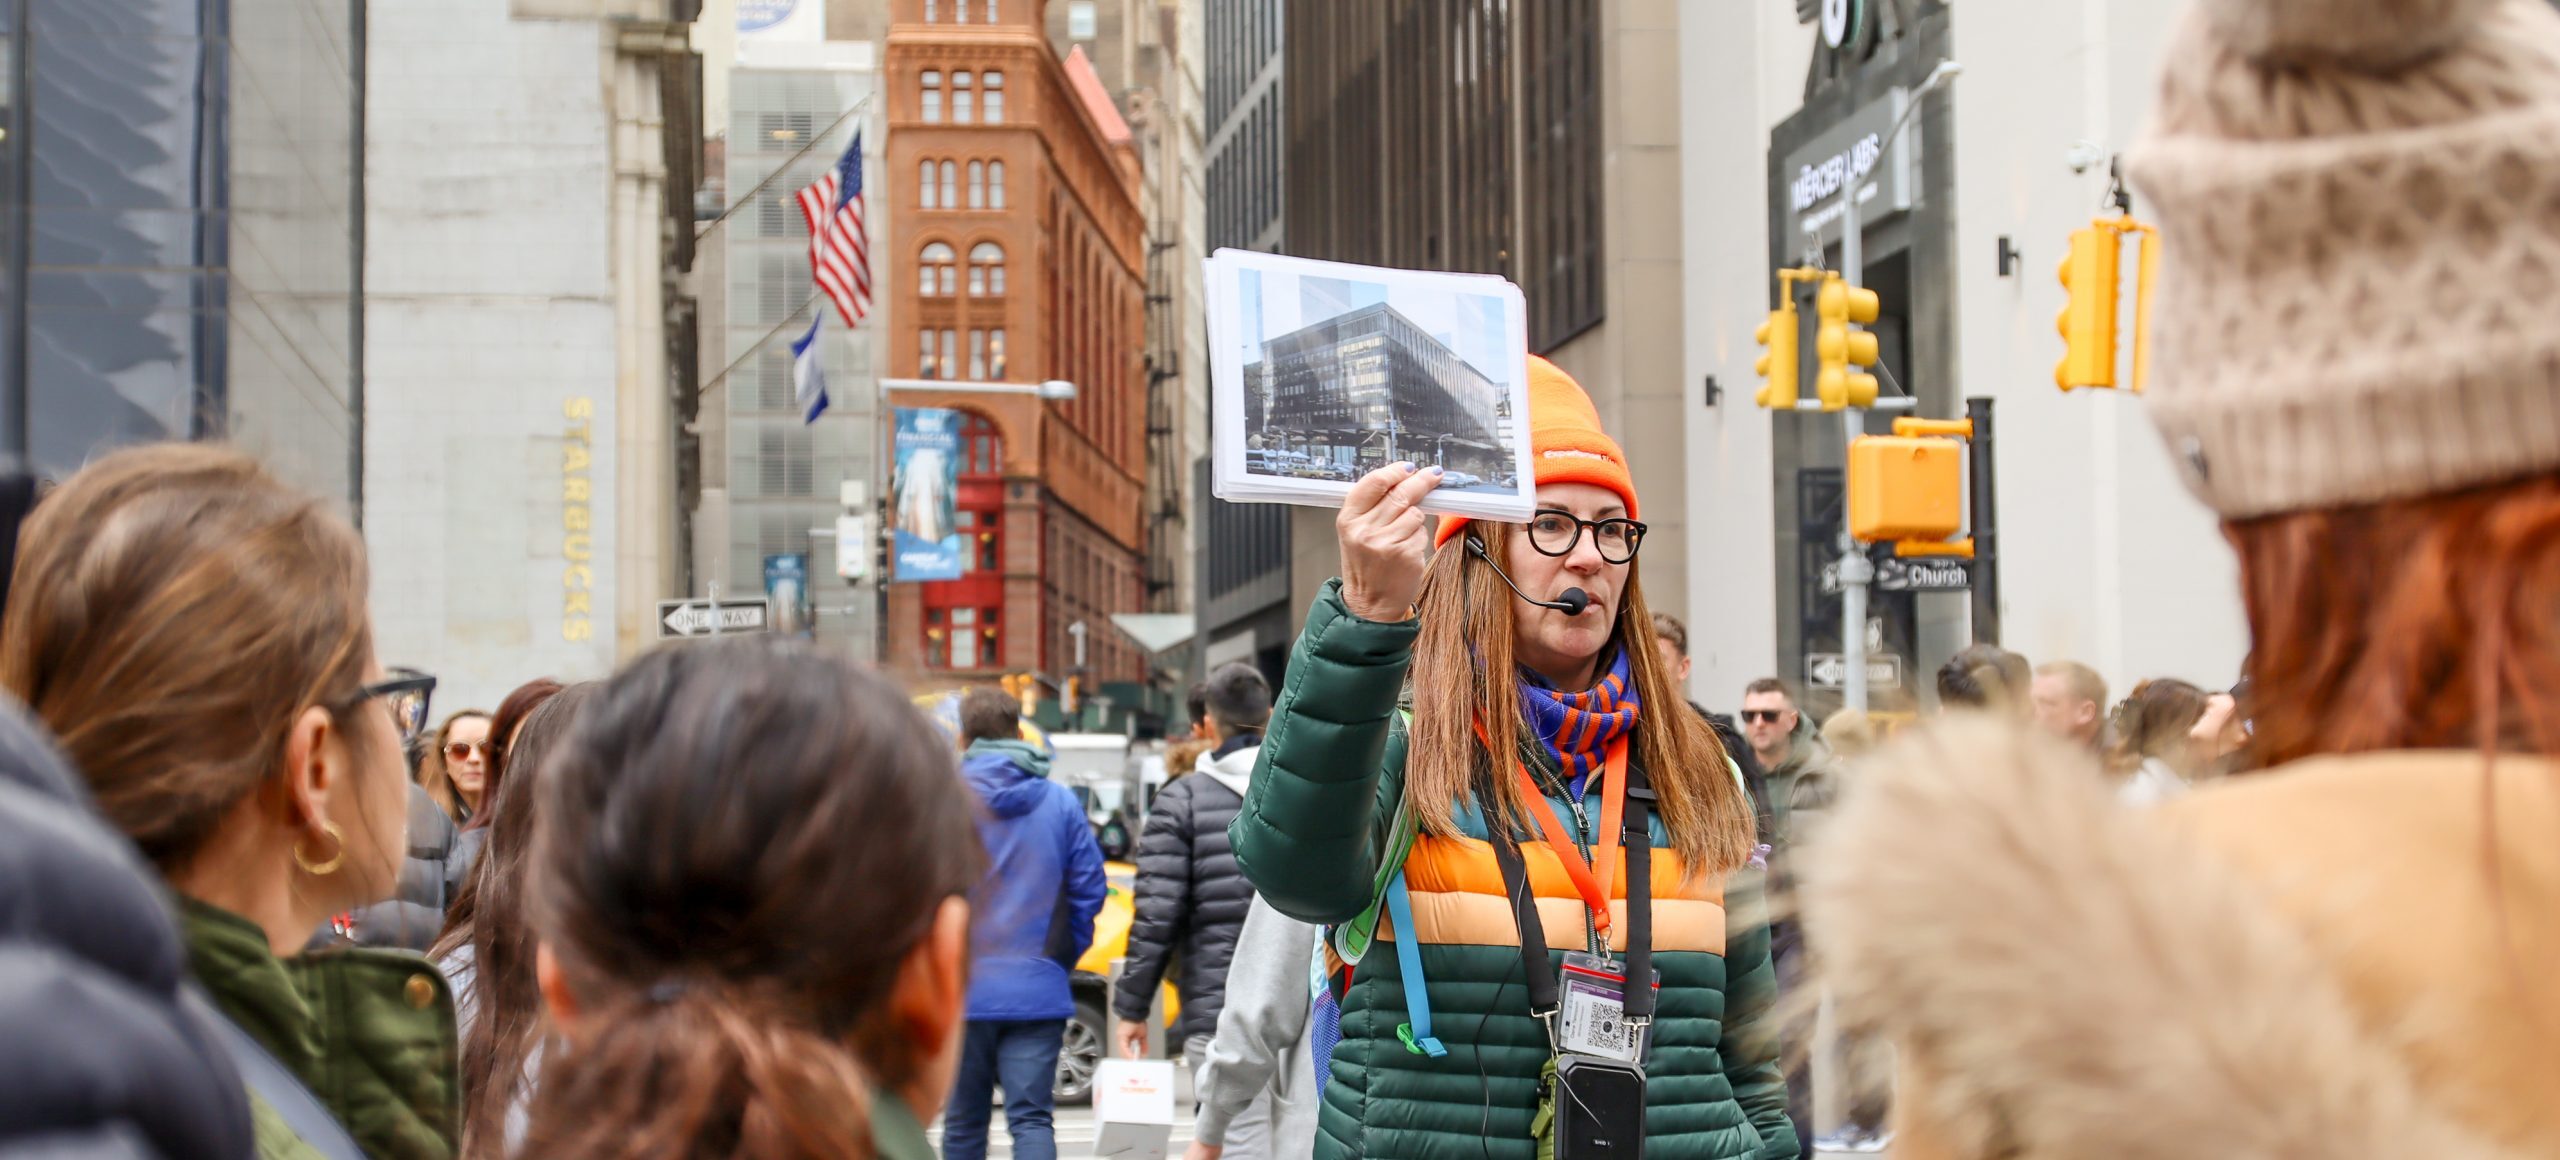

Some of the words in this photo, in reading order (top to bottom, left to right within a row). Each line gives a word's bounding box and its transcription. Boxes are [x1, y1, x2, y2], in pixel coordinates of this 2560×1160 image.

[1843, 132, 1880, 180] LABS
[562, 395, 594, 642] STARBUCKS
[1910, 565, 1967, 586] Church
[674, 612, 706, 628] ONE
[720, 611, 752, 626] WAY
